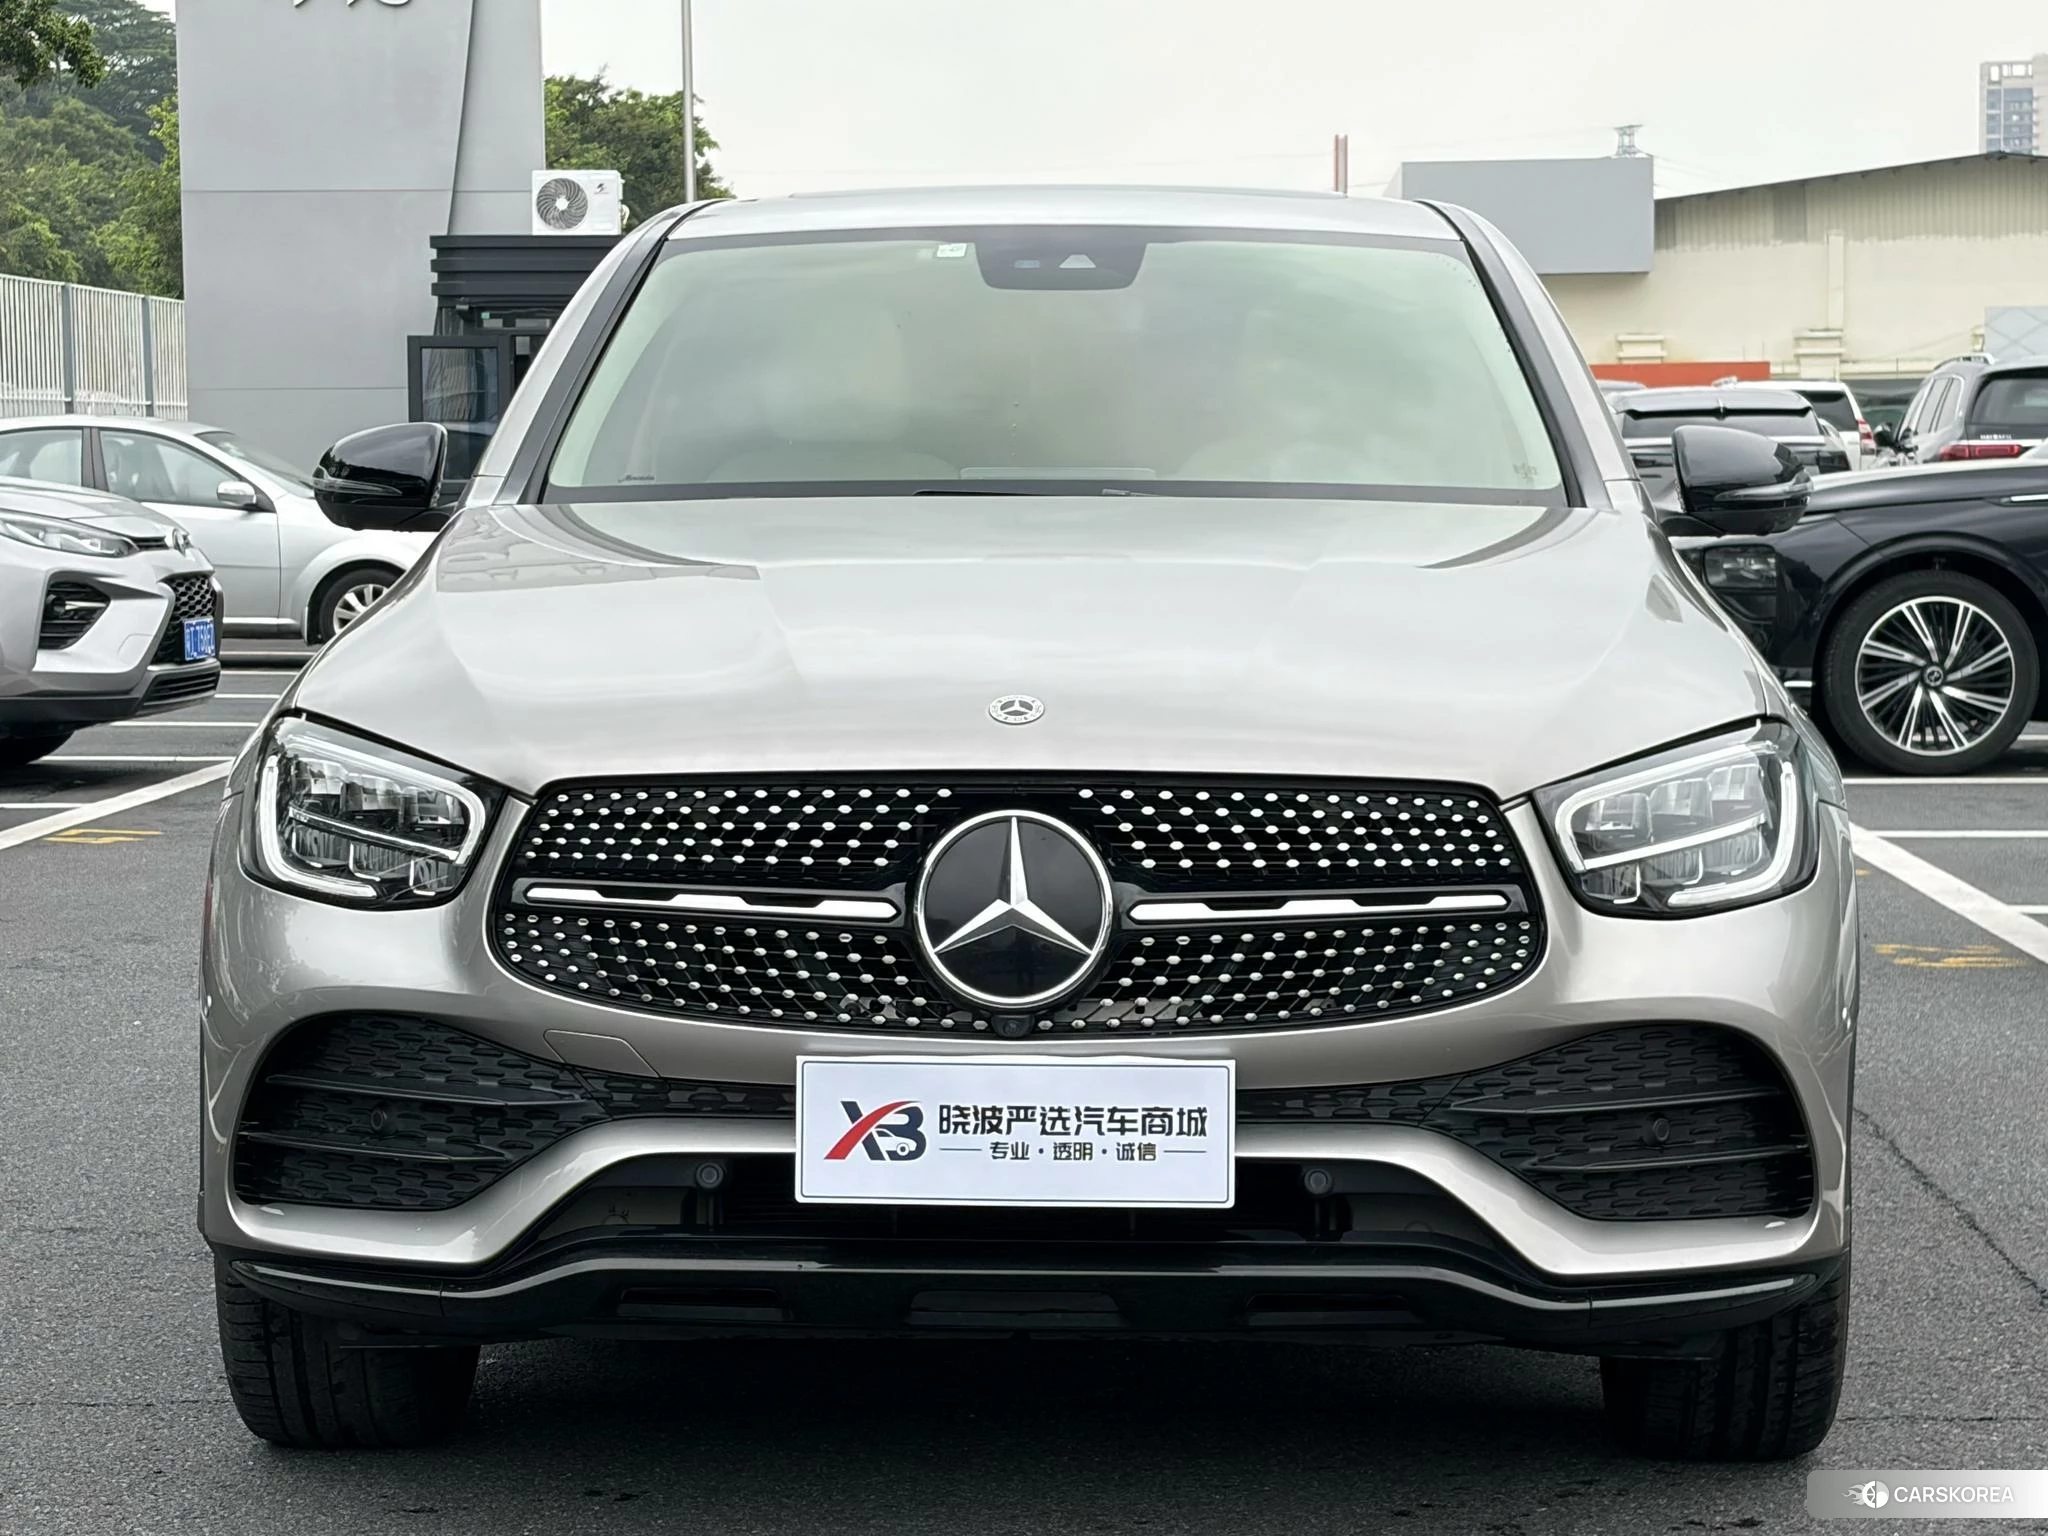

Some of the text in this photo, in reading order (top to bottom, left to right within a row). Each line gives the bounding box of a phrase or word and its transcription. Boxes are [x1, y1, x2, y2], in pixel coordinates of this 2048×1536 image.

[938, 1104, 1208, 1138] 晓波严选汽车商城
